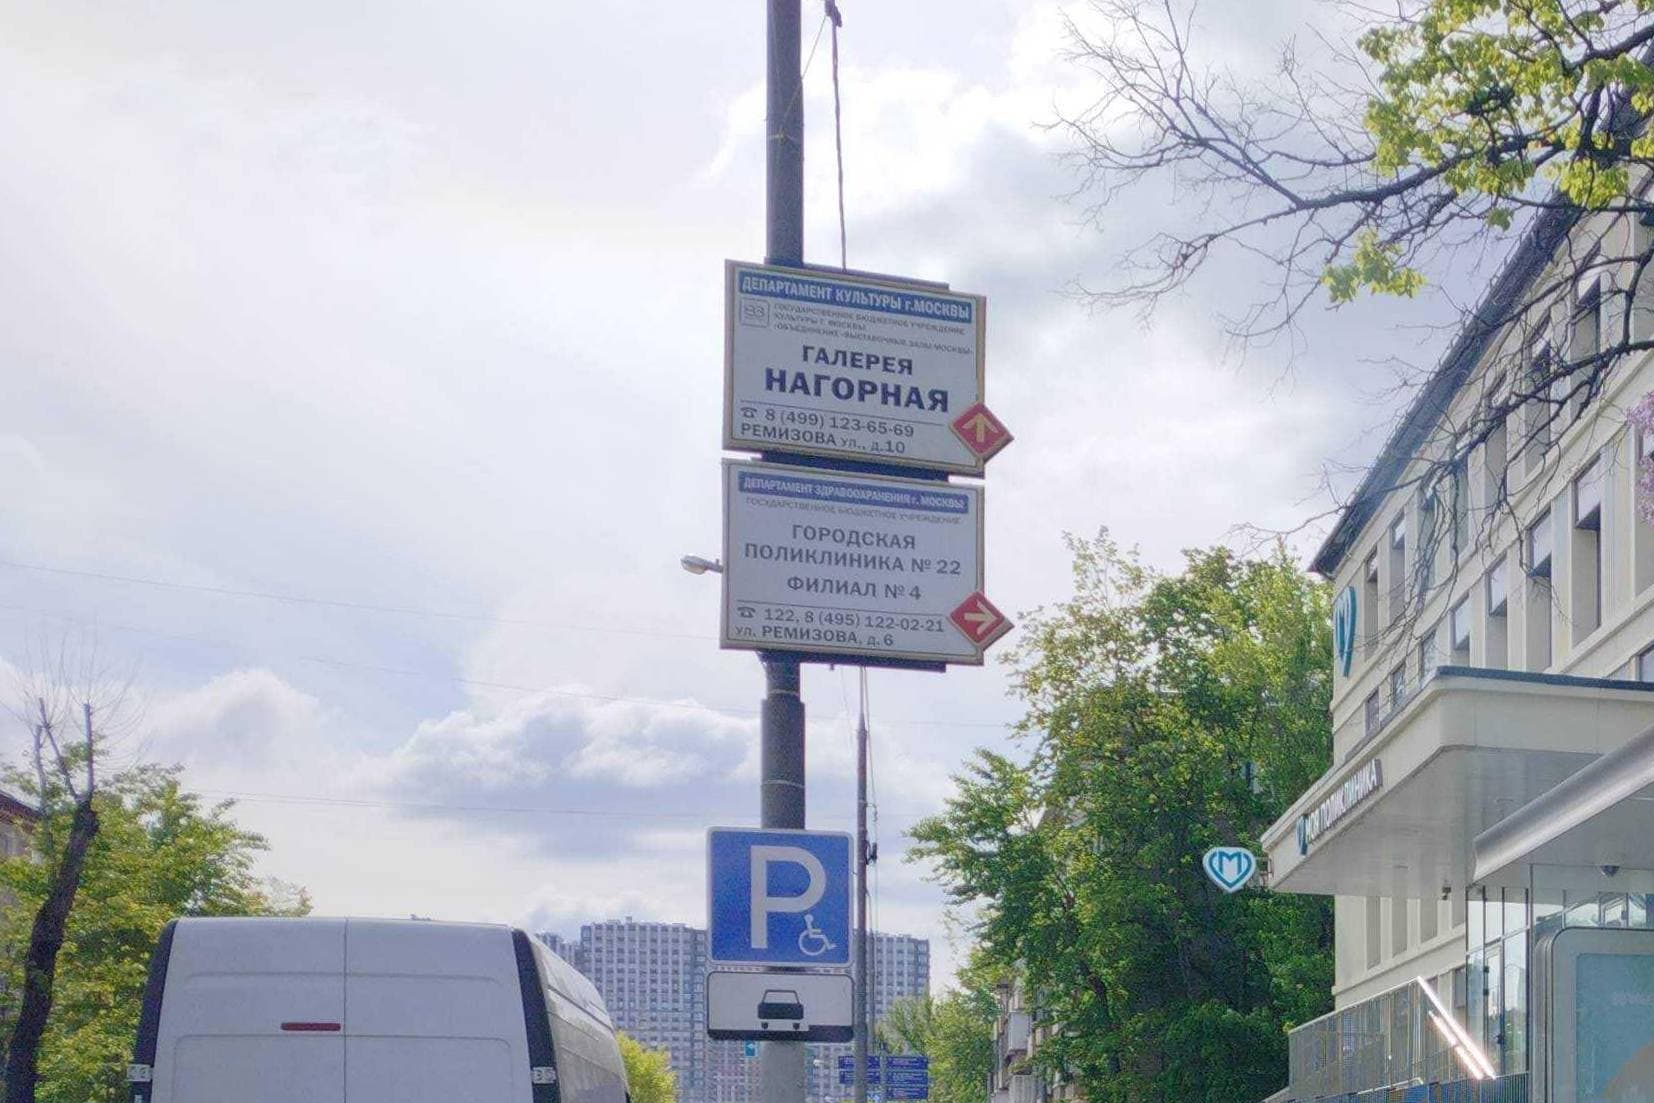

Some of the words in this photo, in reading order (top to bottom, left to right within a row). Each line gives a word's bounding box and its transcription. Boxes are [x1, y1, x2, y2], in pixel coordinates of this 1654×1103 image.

[742, 276, 832, 300] ДЕПАРТАМЕНТ
[836, 288, 900, 309] КУЛЬТУРЫ
[802, 345, 913, 375] ГАЛЕРЕЯ
[765, 367, 949, 413] НАГОРНАЯ
[740, 423, 837, 446] РЕМИЗОВА
[765, 409, 775, 422] 8
[780, 410, 825, 429] (499)
[830, 416, 914, 438] 123-65-69
[743, 476, 813, 493] ДЕПАРТАМЕНТ
[814, 484, 911, 504] ЗДРАВООХРАНЕНИЯ
[792, 525, 915, 550] ГОРОДСКАЯ
[745, 542, 904, 573] ПОЛИКЛИНИКА
[911, 557, 932, 572] №
[936, 560, 961, 575] 22
[787, 575, 876, 599] ФИЛИАЛ
[884, 583, 905, 599] №
[909, 585, 921, 600] 4
[805, 611, 815, 623] 8
[818, 611, 860, 628] (495)
[864, 615, 944, 633] 122-02-21
[884, 634, 894, 647] 6
[750, 845, 827, 949] P
